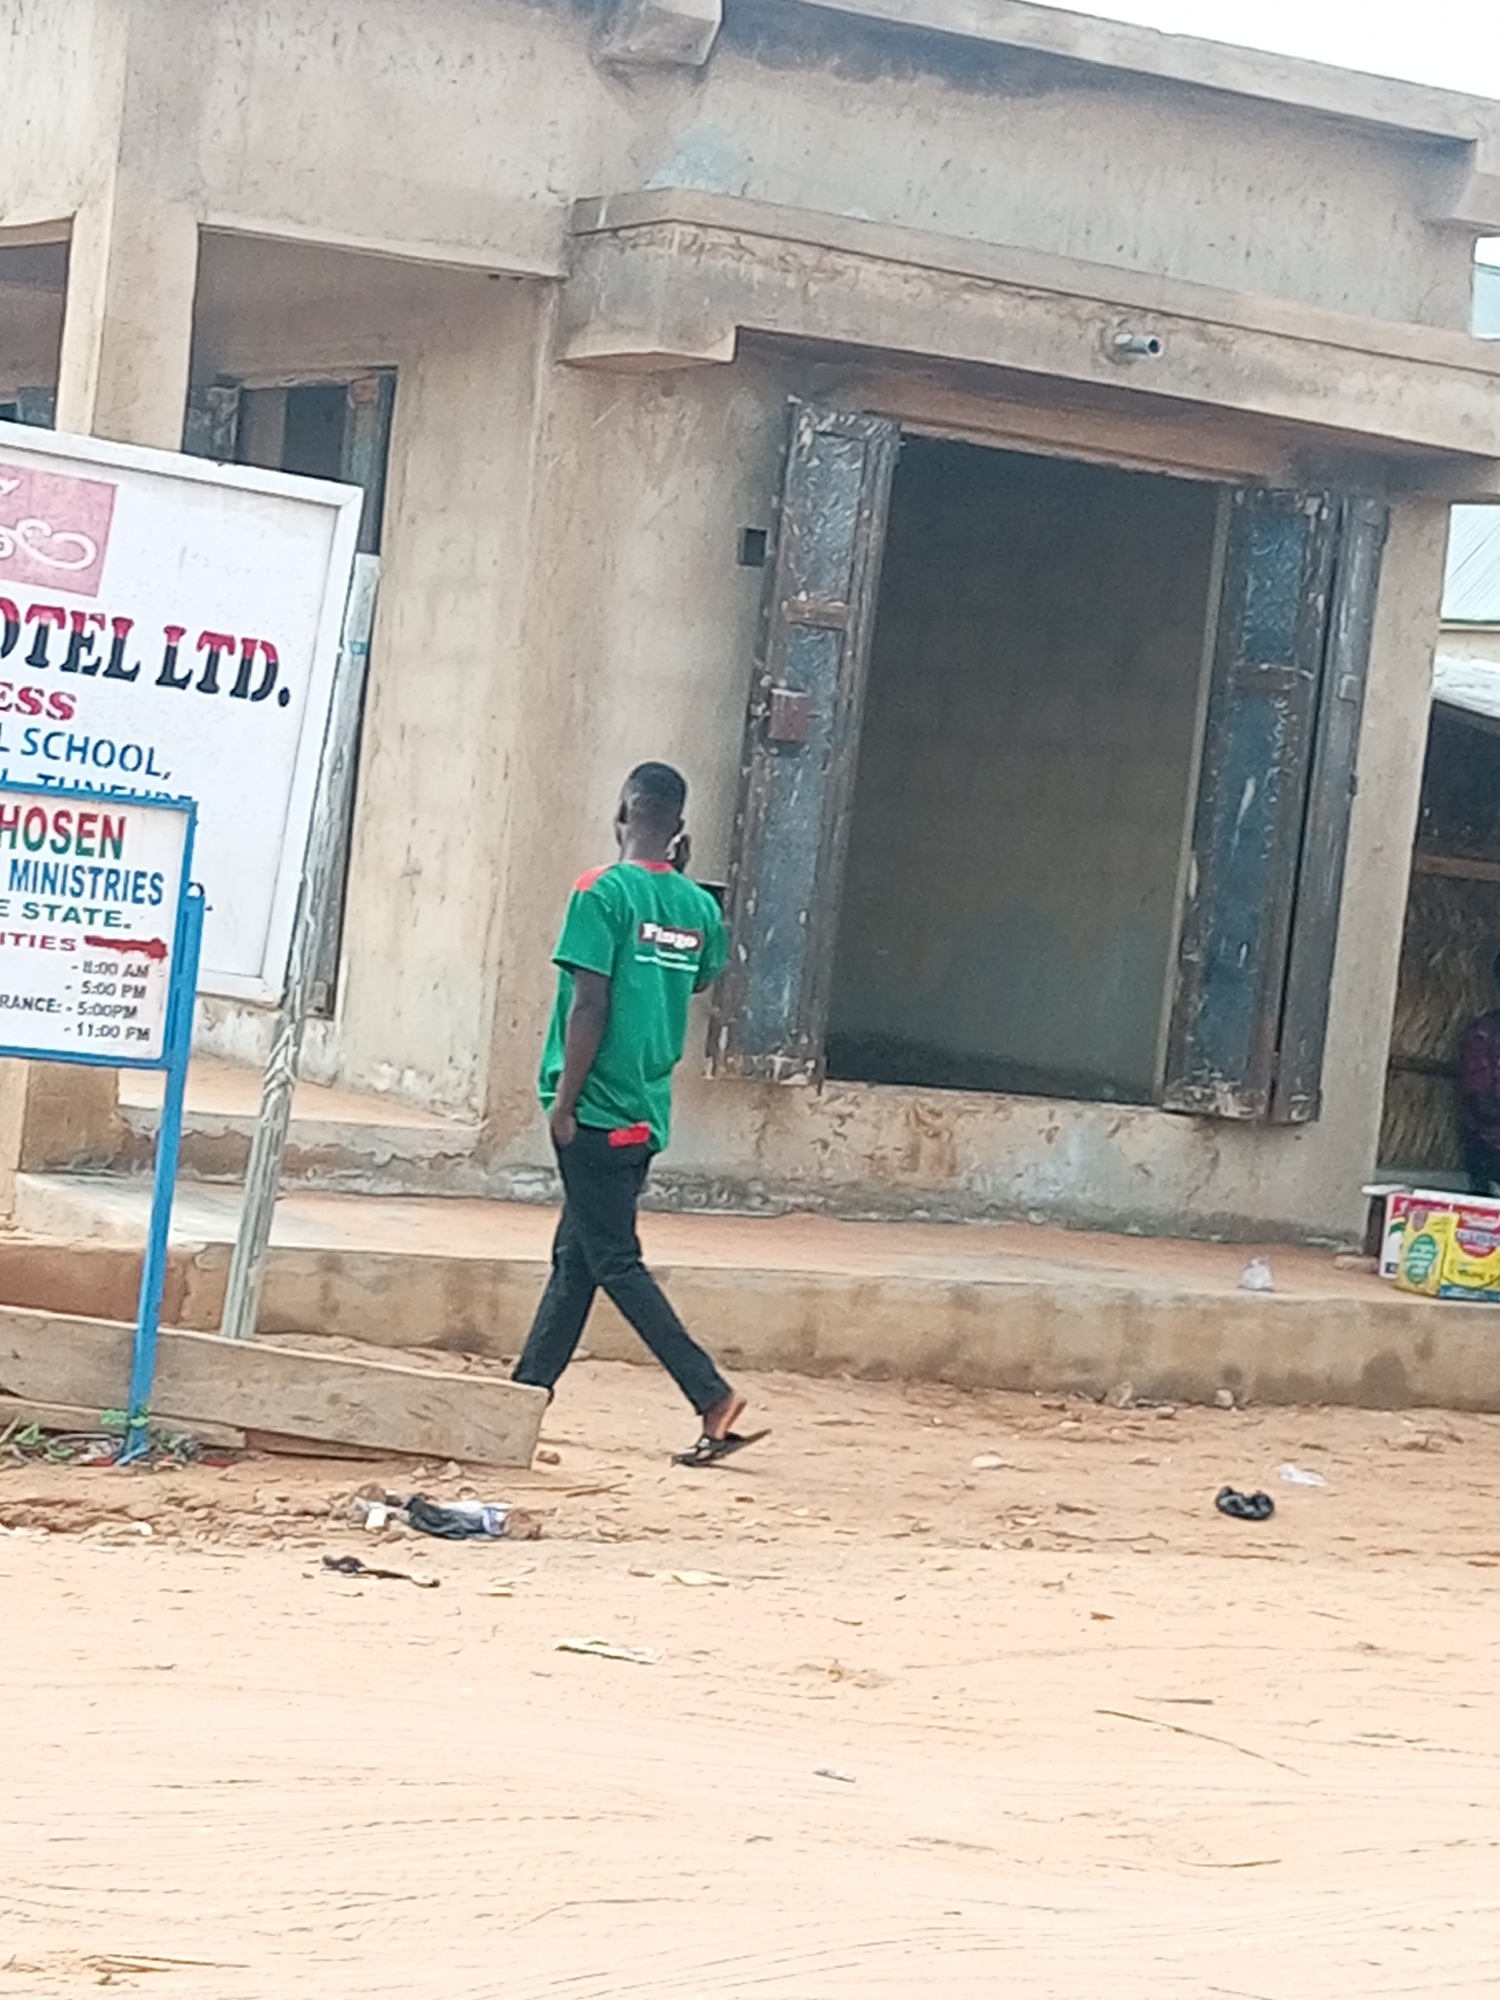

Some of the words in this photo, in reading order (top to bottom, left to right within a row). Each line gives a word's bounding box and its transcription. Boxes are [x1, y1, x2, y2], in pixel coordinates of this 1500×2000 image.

[155, 624, 290, 708] LTD.
[20, 727, 172, 780] SCHOOL,
[8, 859, 164, 906] MINISTRIES
[21, 901, 131, 929] STATE.
[81, 980, 116, 996] 5:00
[121, 984, 146, 999] PM
[77, 1022, 121, 1039] 11:00
[125, 1026, 151, 1041] PM
